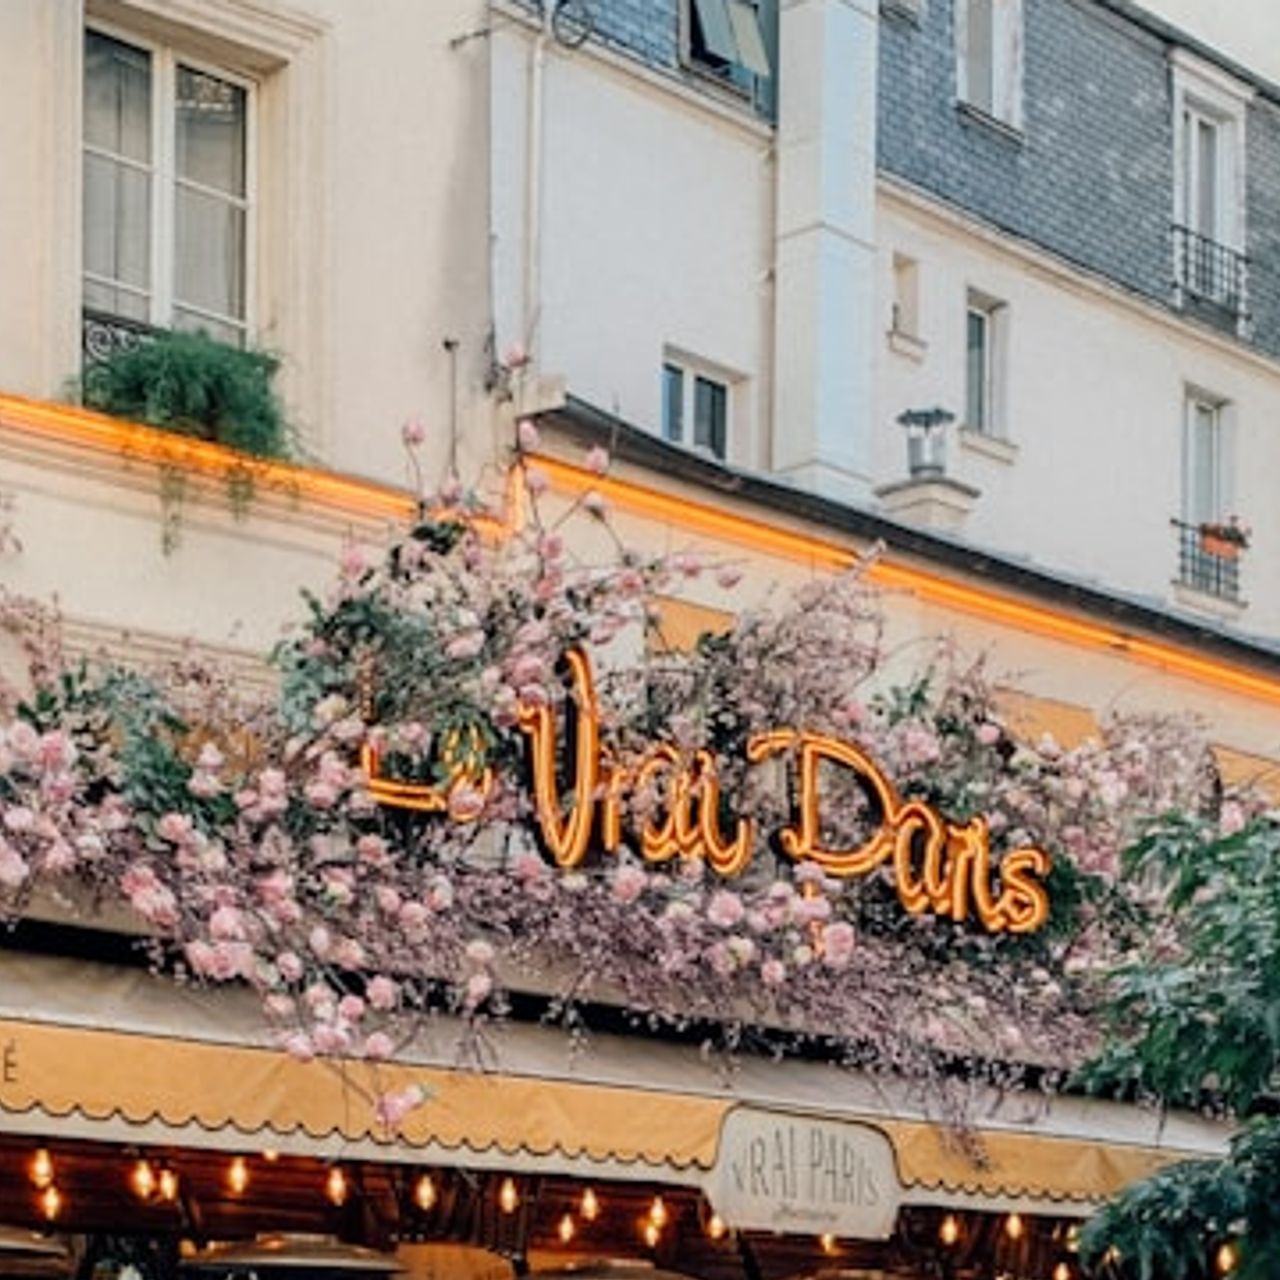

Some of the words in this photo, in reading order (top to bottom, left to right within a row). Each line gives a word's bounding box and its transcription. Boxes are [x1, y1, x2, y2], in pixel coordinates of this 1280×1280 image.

[517, 645, 757, 875] Vrai
[731, 1124, 798, 1199] VRAI
[808, 1125, 881, 1207] PARIS
